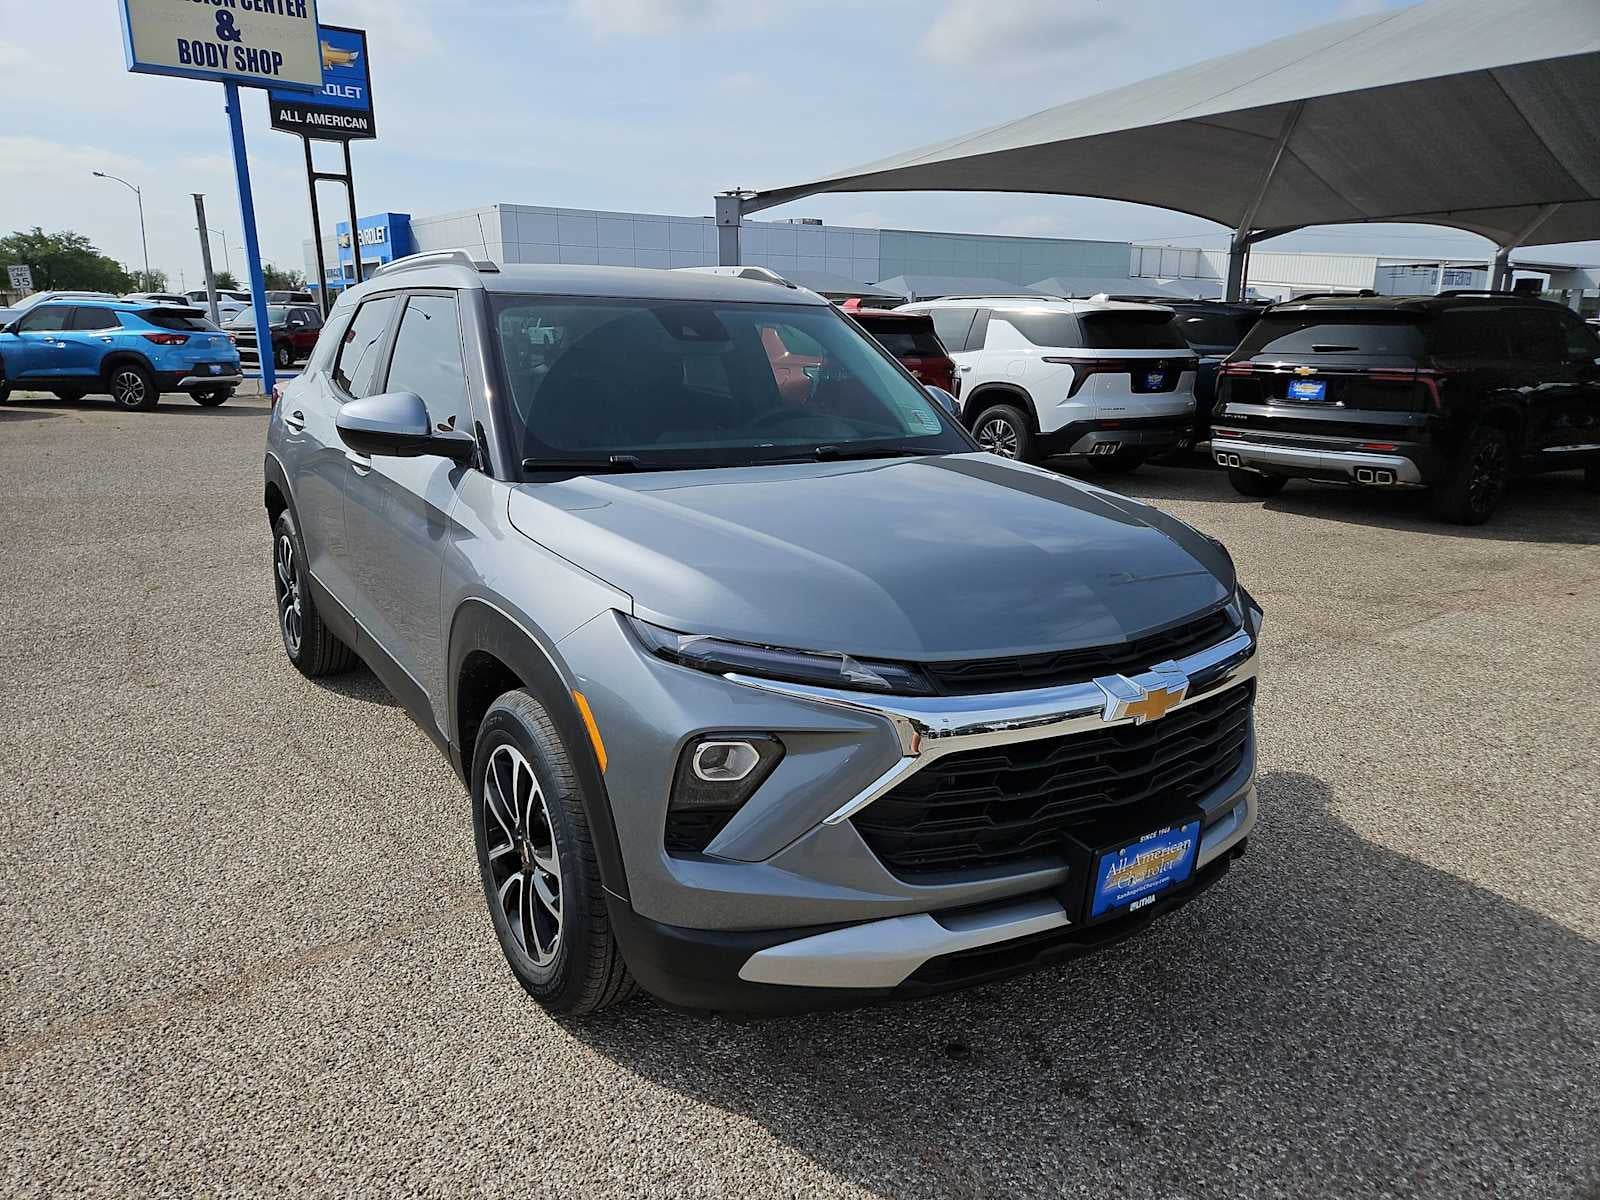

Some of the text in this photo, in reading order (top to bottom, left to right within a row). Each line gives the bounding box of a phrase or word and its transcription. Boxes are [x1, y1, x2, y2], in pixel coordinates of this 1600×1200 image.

[216, 9, 242, 42] &
[177, 39, 283, 76] BODY SHOP
[321, 83, 362, 99] OLET
[280, 109, 368, 130] ALL AMERICAN
[13, 277, 30, 287] 35
[1139, 830, 1158, 843] SINCE
[1105, 839, 1191, 879] All American
[1117, 858, 1175, 889] Chevrolet
[1136, 894, 1156, 910] LITHIA
